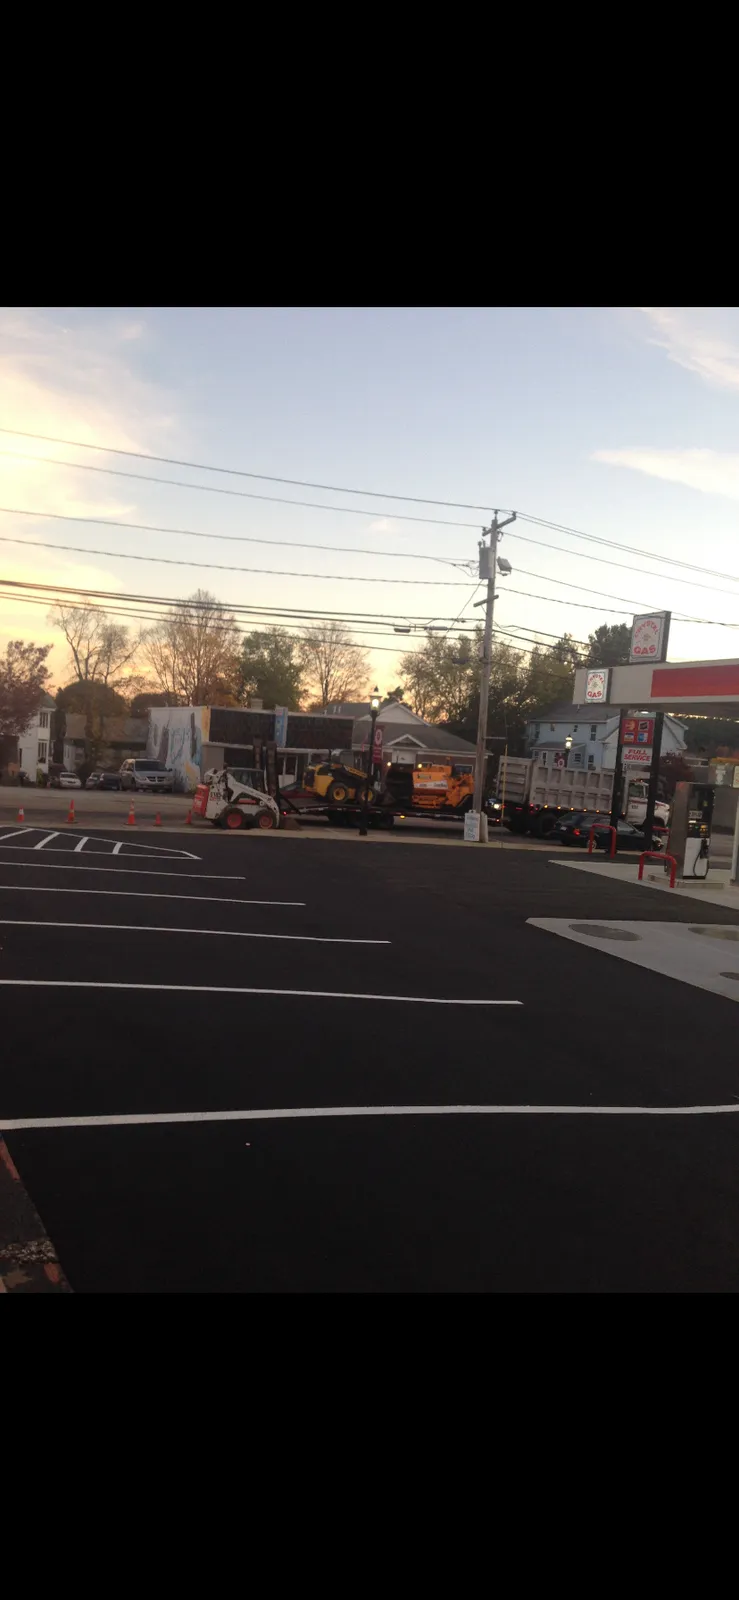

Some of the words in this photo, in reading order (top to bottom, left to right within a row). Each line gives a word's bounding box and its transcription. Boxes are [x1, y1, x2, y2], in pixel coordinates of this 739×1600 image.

[634, 620, 659, 638] CRYSTAL
[633, 644, 656, 655] GAS
[587, 690, 602, 698] GAS
[623, 754, 651, 762] SERVICE
